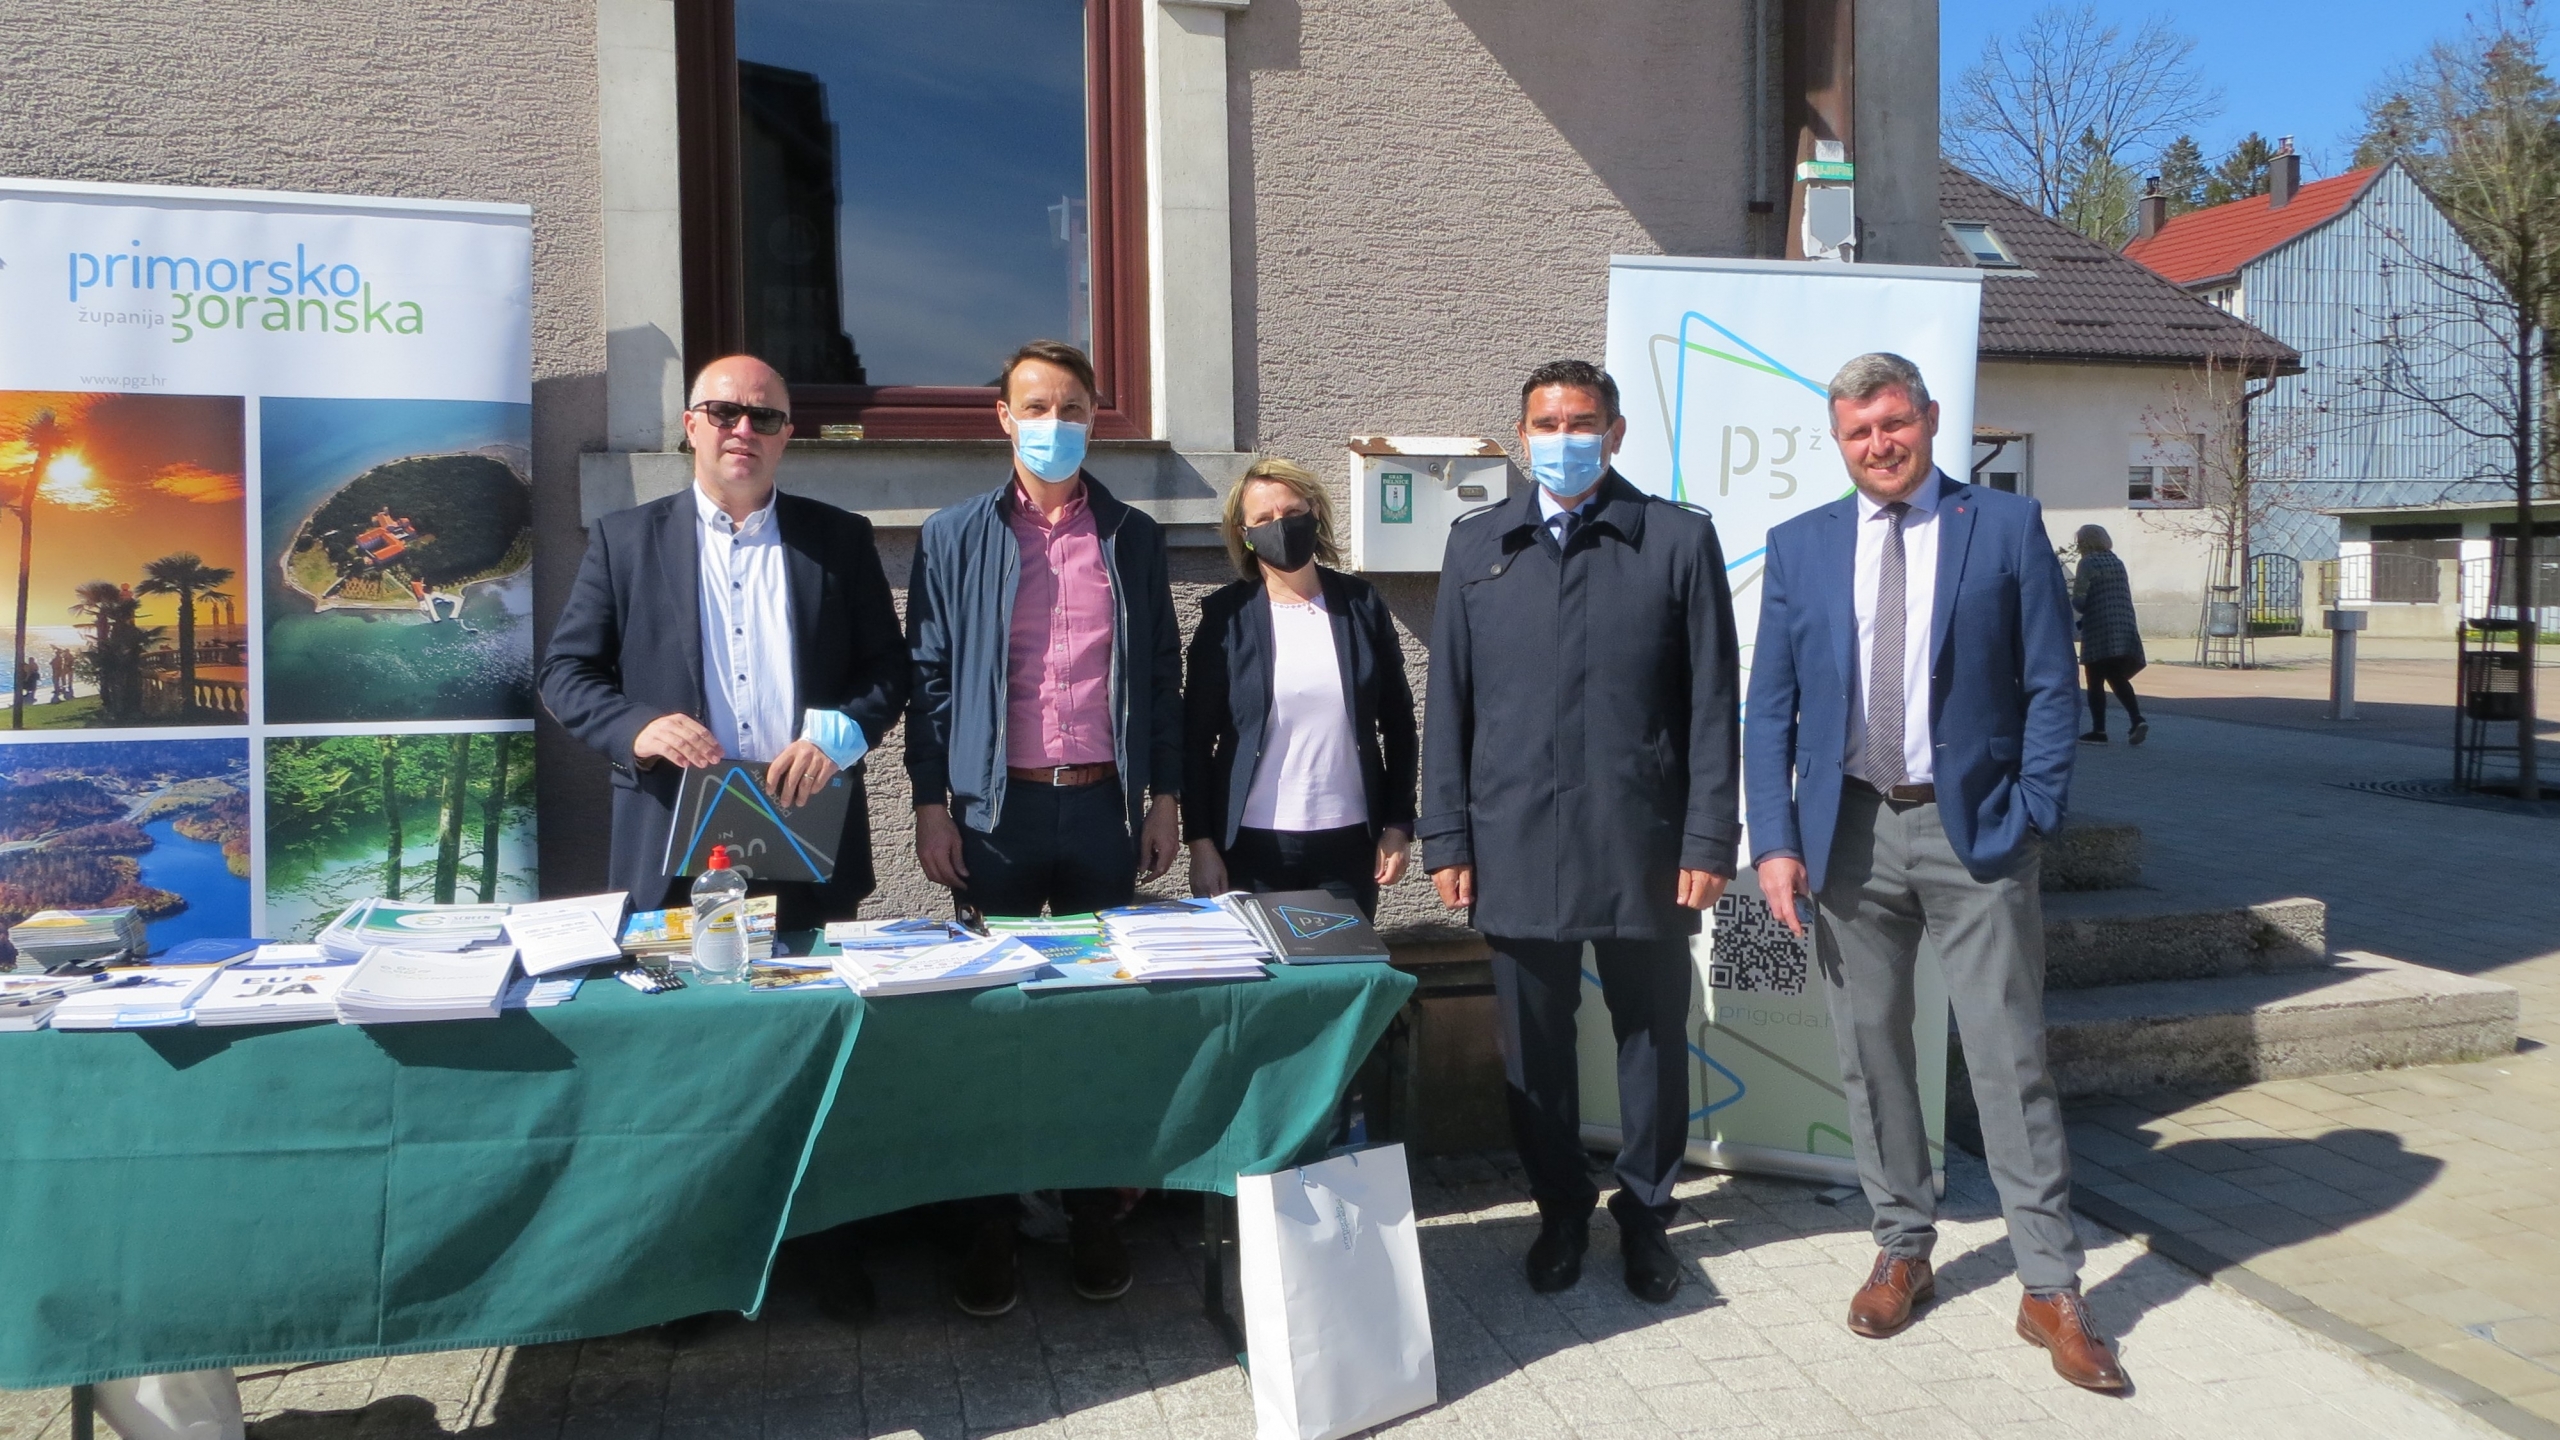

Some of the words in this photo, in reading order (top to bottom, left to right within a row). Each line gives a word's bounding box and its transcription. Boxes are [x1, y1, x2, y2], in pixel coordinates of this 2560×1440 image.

[69, 239, 360, 302] primorsko
[78, 305, 165, 329] županija
[171, 281, 424, 343] goranska
[80, 372, 167, 389] www.pgz.hr
[232, 983, 318, 998] JA
[241, 976, 292, 985] EU
